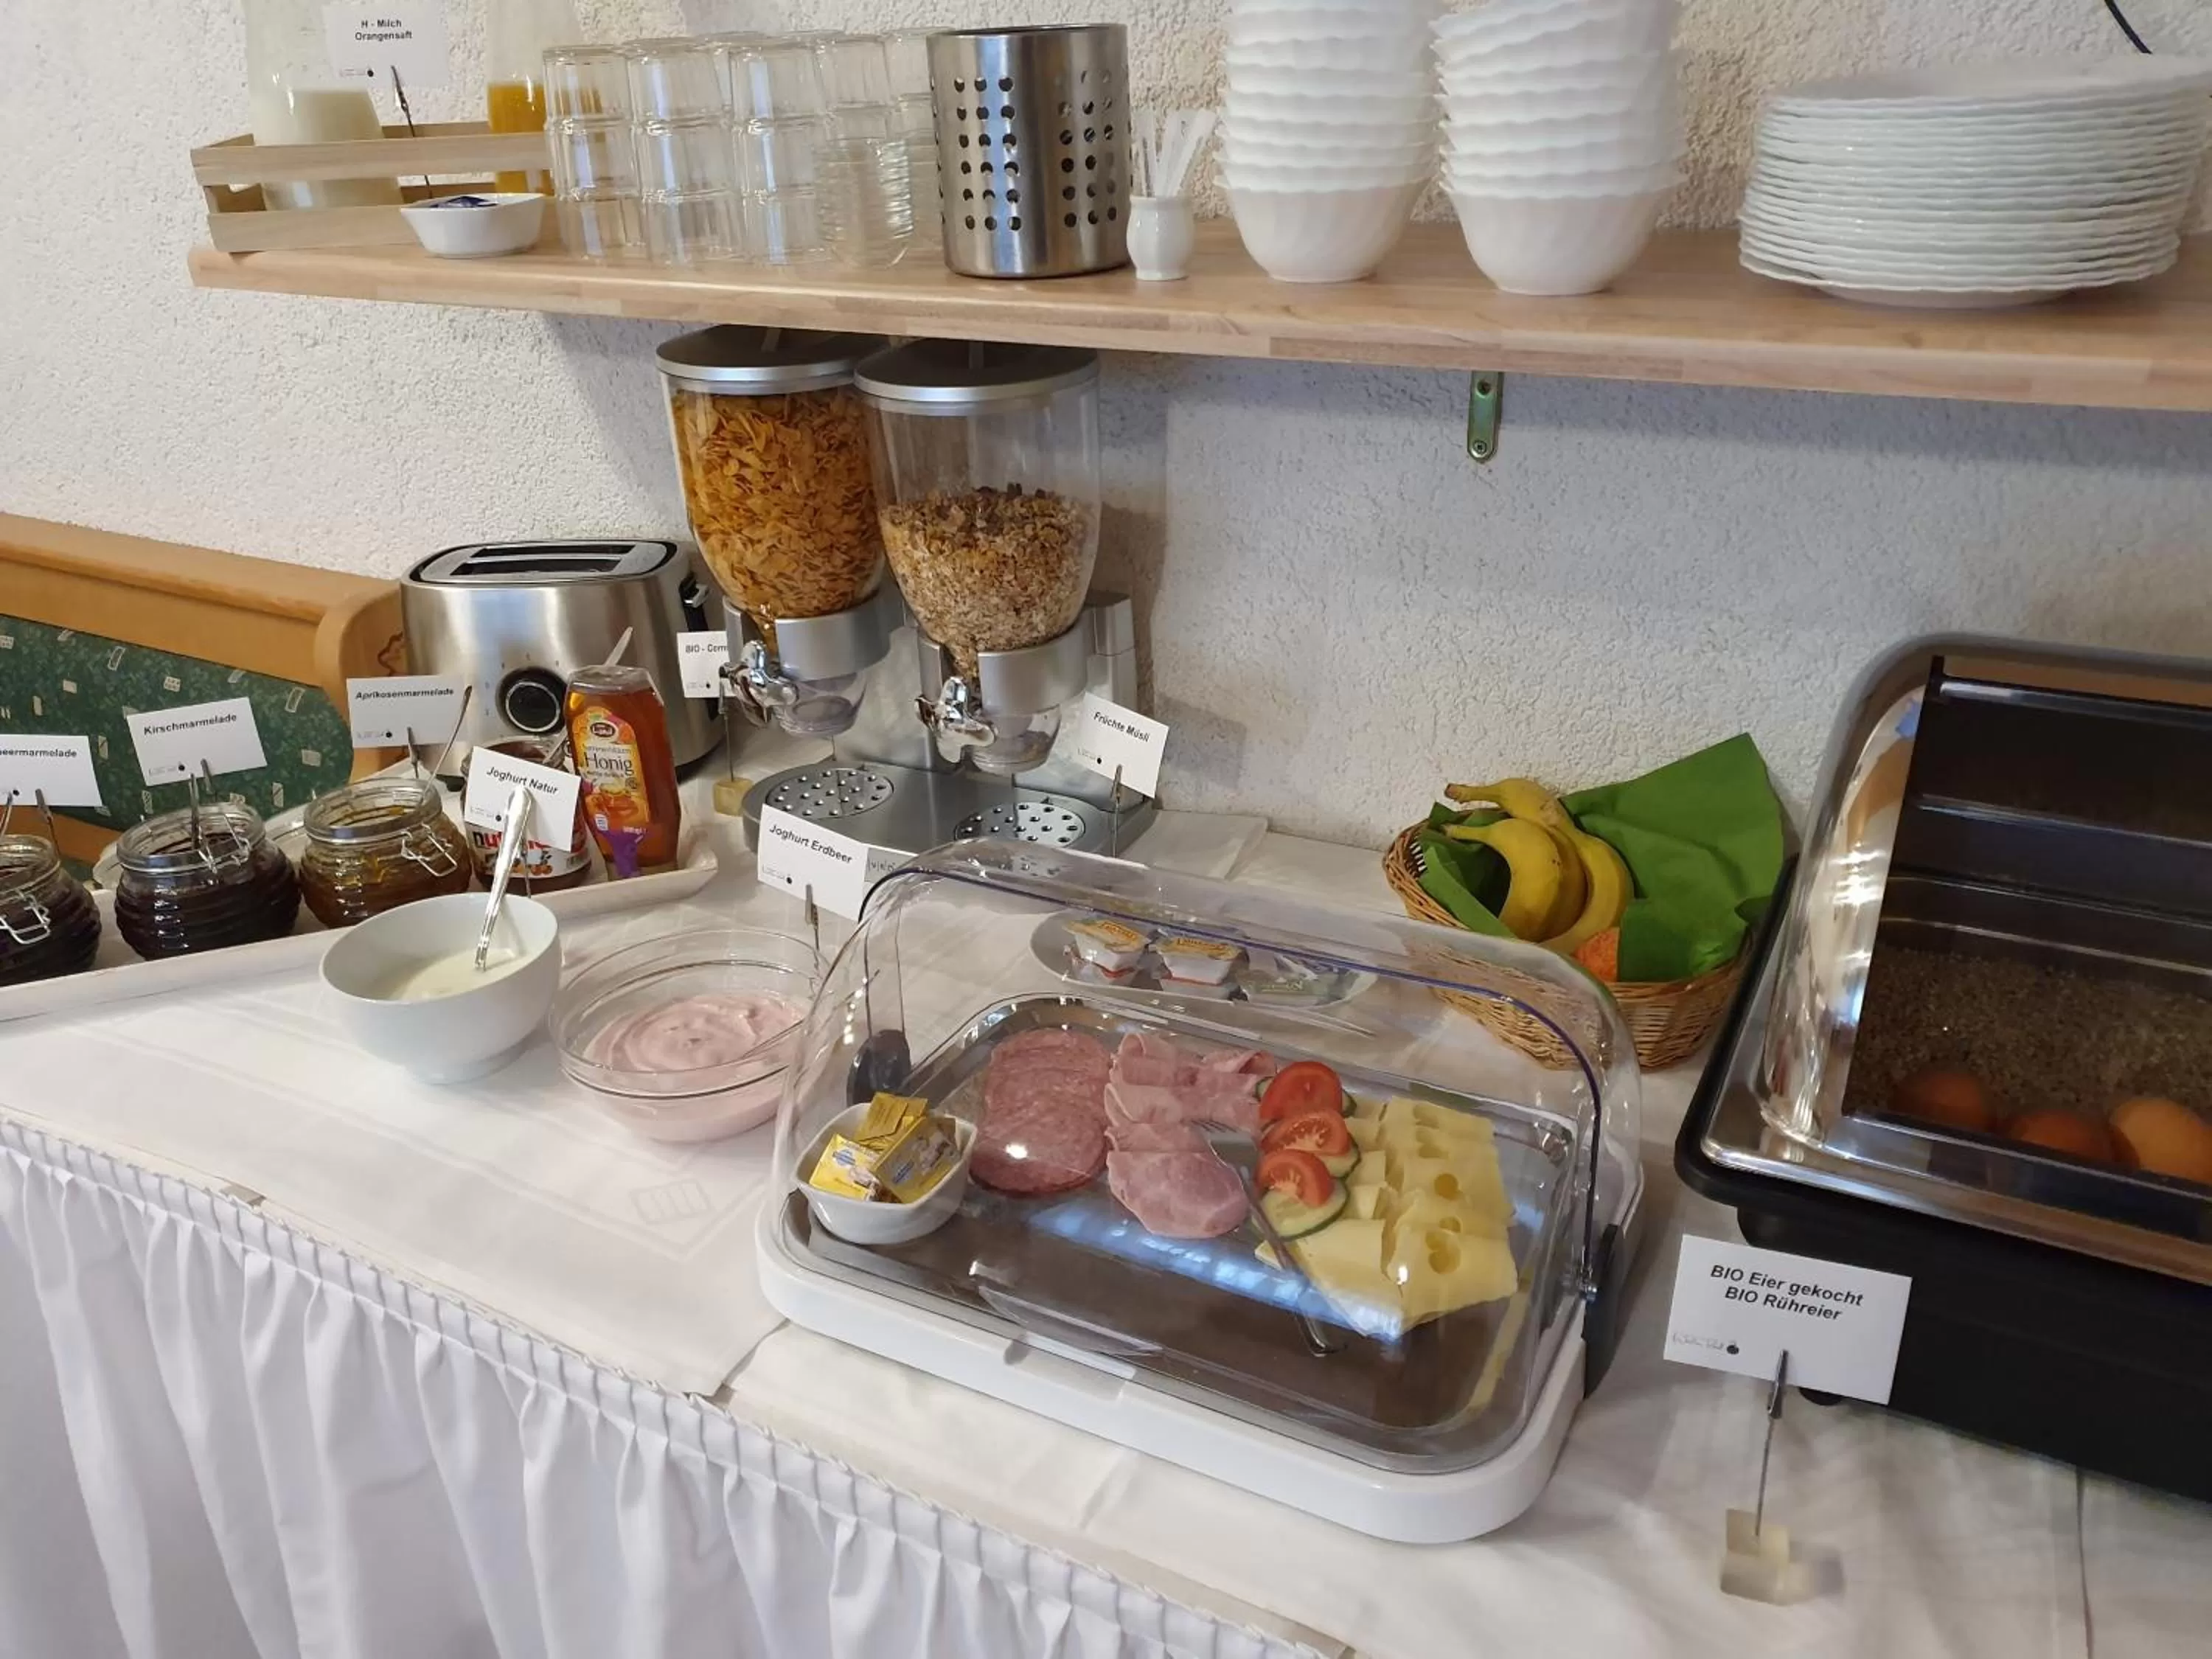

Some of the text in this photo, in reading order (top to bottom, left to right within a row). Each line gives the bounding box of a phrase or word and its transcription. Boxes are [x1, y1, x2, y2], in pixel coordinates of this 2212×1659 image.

[355, 31, 412, 42] Orangensaft
[361, 20, 368, 29] H
[377, 19, 402, 28] Milch
[685, 644, 700, 653] BIO
[707, 643, 728, 653] Corn
[355, 688, 454, 700] Aprikosenmarmelade
[144, 713, 237, 735] Kirschmarmelade
[1093, 711, 1150, 742] Früchte Müsli
[583, 751, 635, 776] Honig
[487, 766, 559, 795] Joghurt Natur
[769, 824, 853, 864] Joghurt Erdbeer
[1710, 1265, 1864, 1307] BIO Eier gekocht
[1725, 1286, 1842, 1321] BIO Rühreier
